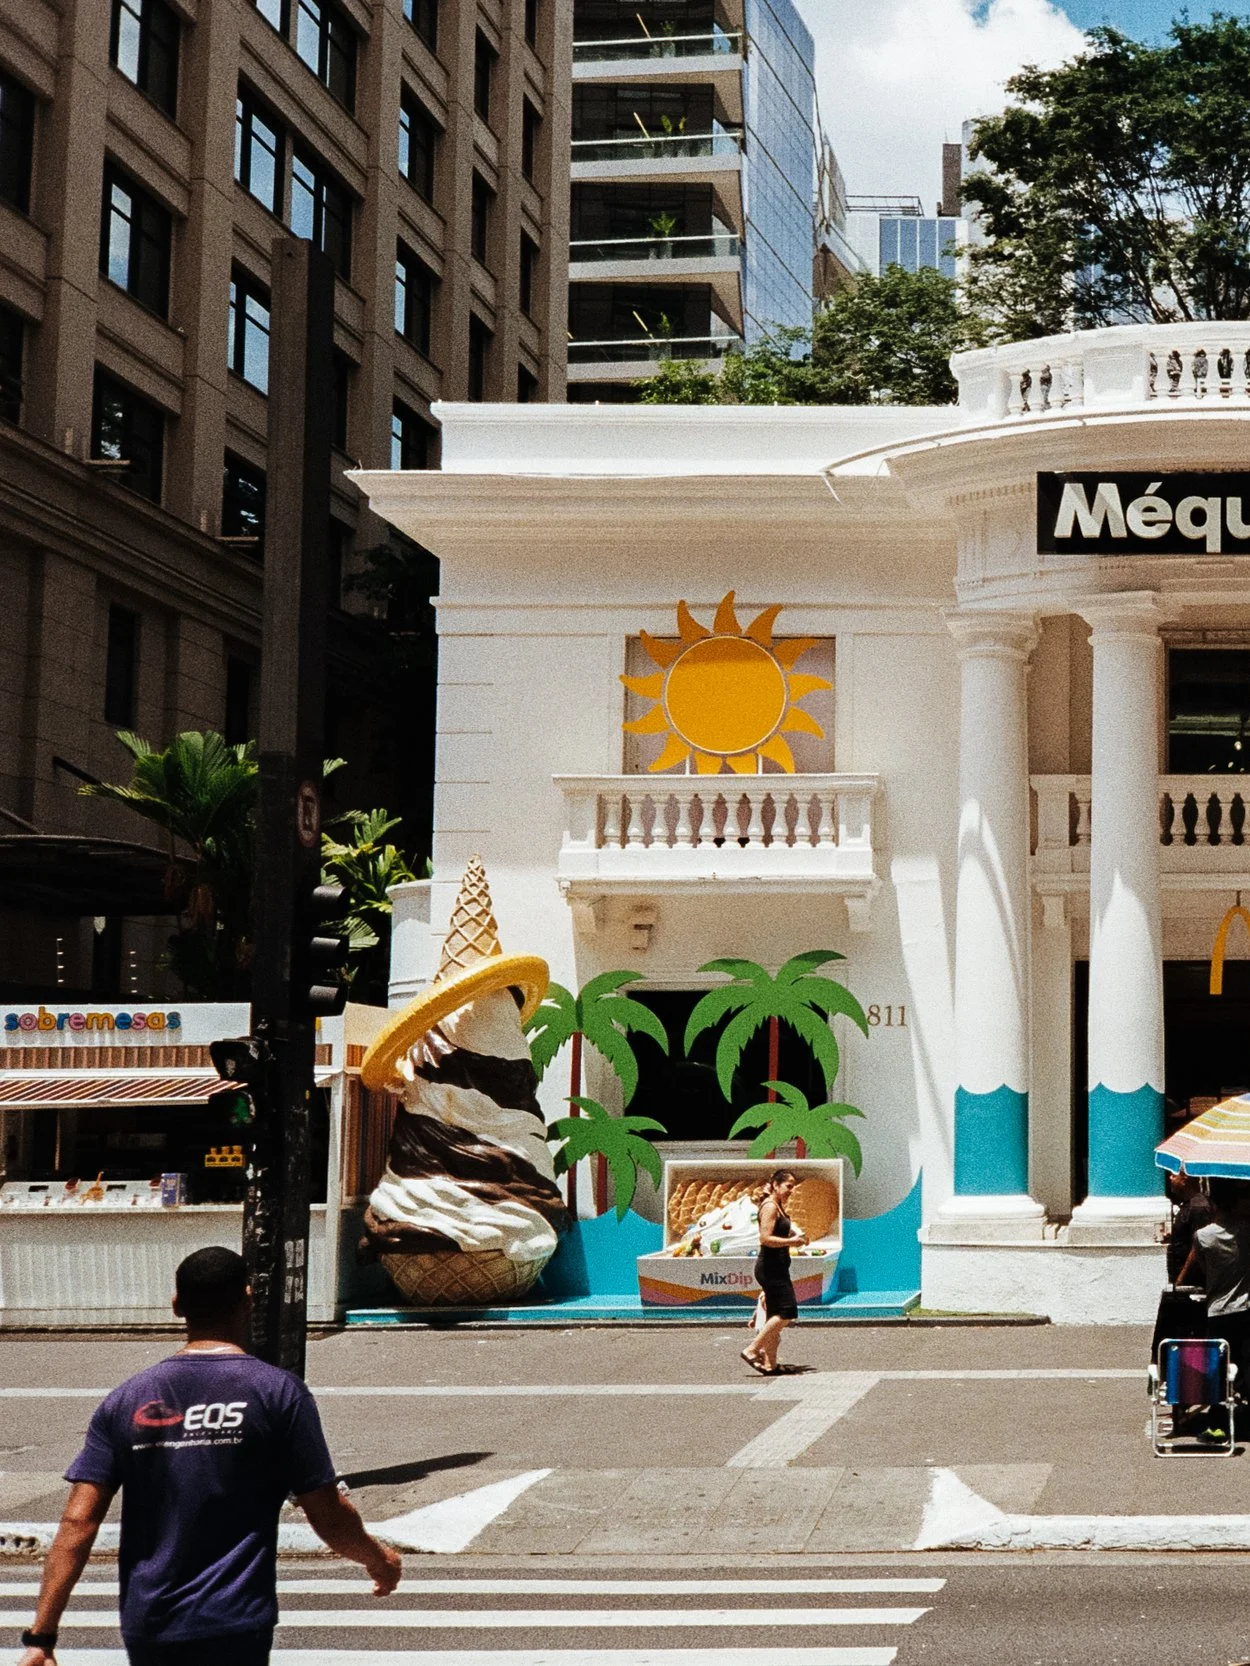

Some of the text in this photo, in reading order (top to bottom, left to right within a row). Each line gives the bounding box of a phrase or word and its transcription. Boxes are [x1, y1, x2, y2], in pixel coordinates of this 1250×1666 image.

[4, 1006, 181, 1031] sobremesas
[701, 1271, 754, 1288] MixDip
[183, 1401, 248, 1430] EQS
